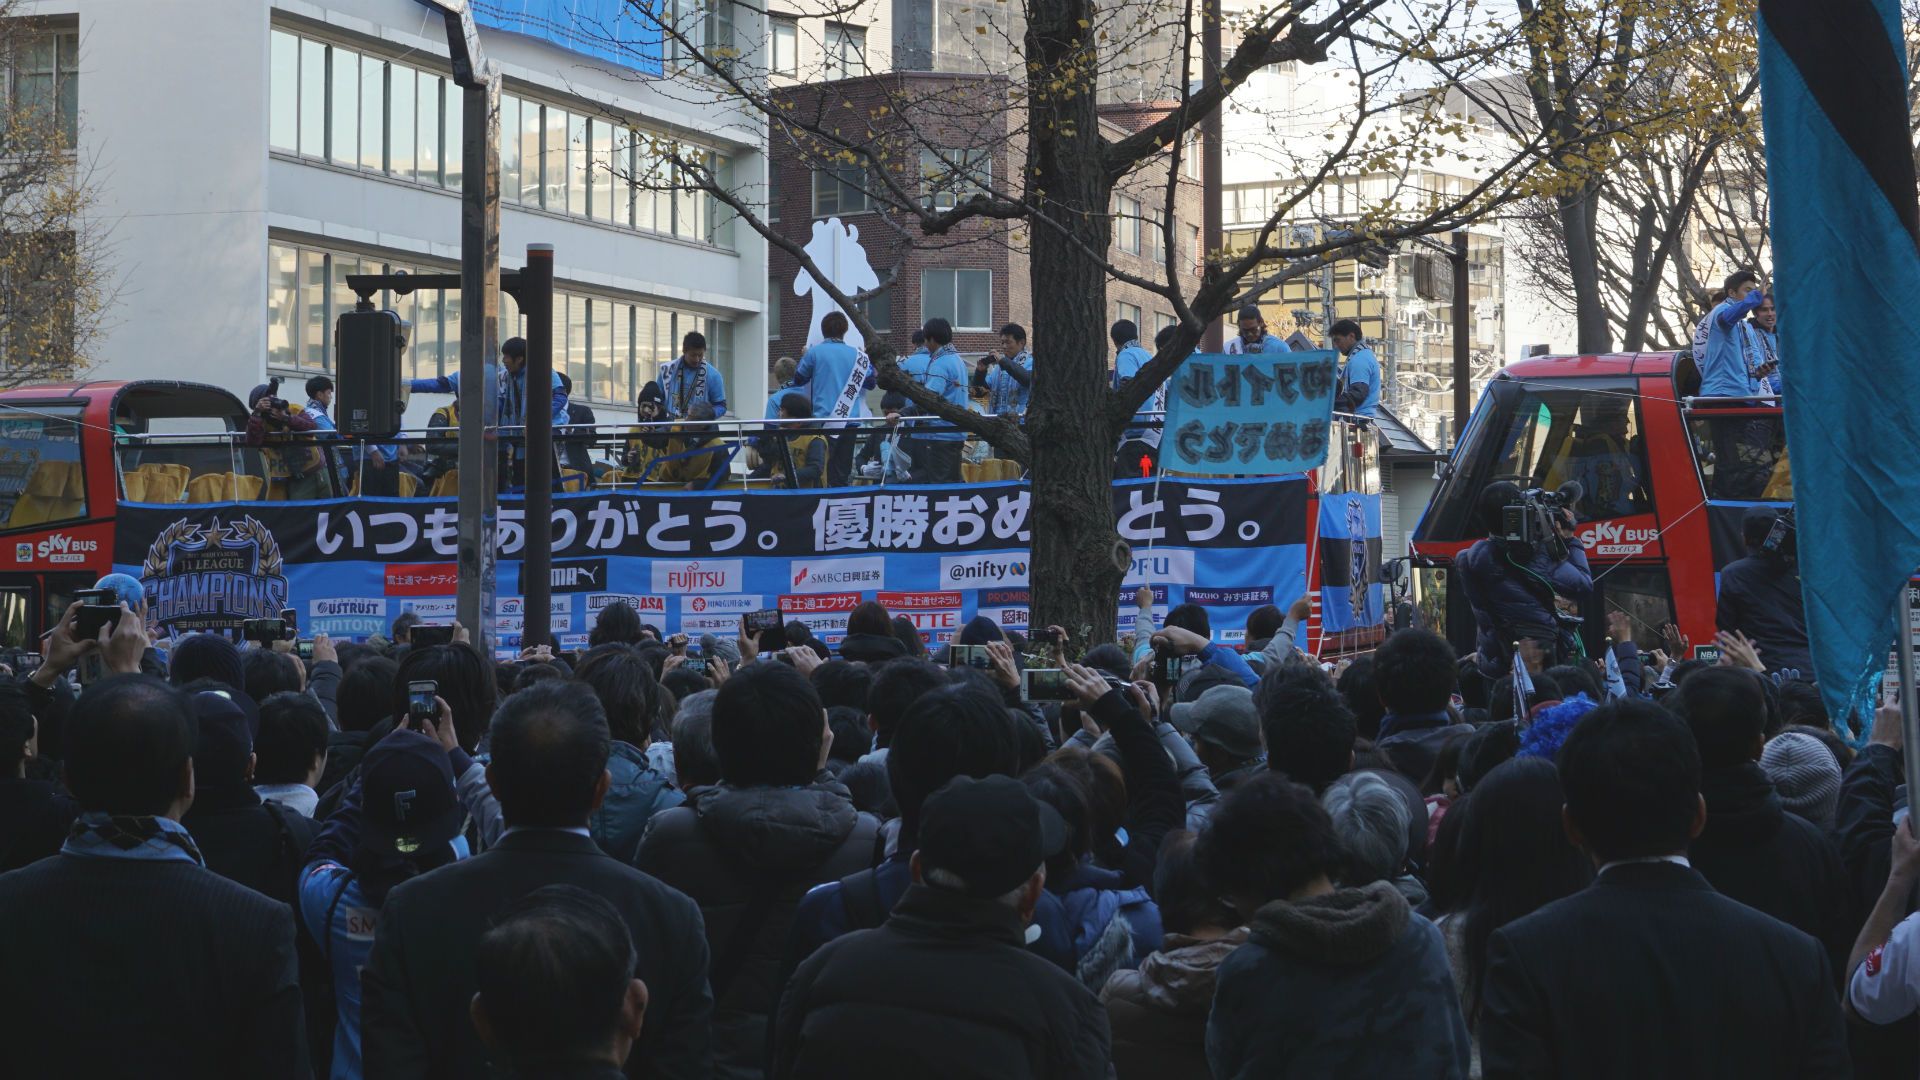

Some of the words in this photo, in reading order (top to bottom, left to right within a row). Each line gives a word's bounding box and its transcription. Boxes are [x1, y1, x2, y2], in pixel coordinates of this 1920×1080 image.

[812, 488, 1260, 553] 優勝おめとう。
[1581, 522, 1625, 549] SKY
[1625, 529, 1660, 541] BUS
[38, 534, 72, 557] SKY
[72, 541, 97, 551] BUS
[1602, 545, 1638, 553] スカイバス
[196, 559, 244, 570] LEAGUE
[950, 561, 1007, 580] @nifty
[668, 562, 726, 592] FUJITSU
[142, 571, 289, 620] CHAMPIONS
[1189, 591, 1219, 600] MIZUHO
[1223, 591, 1270, 601] みずほ証券
[328, 602, 379, 614] USTRUST
[502, 604, 517, 613] SBI
[640, 597, 663, 610] ASA
[781, 596, 858, 610] 富士通エフサス
[311, 618, 384, 632] SUNTORY
[1700, 650, 1719, 660] NBA
[395, 791, 416, 821] F
